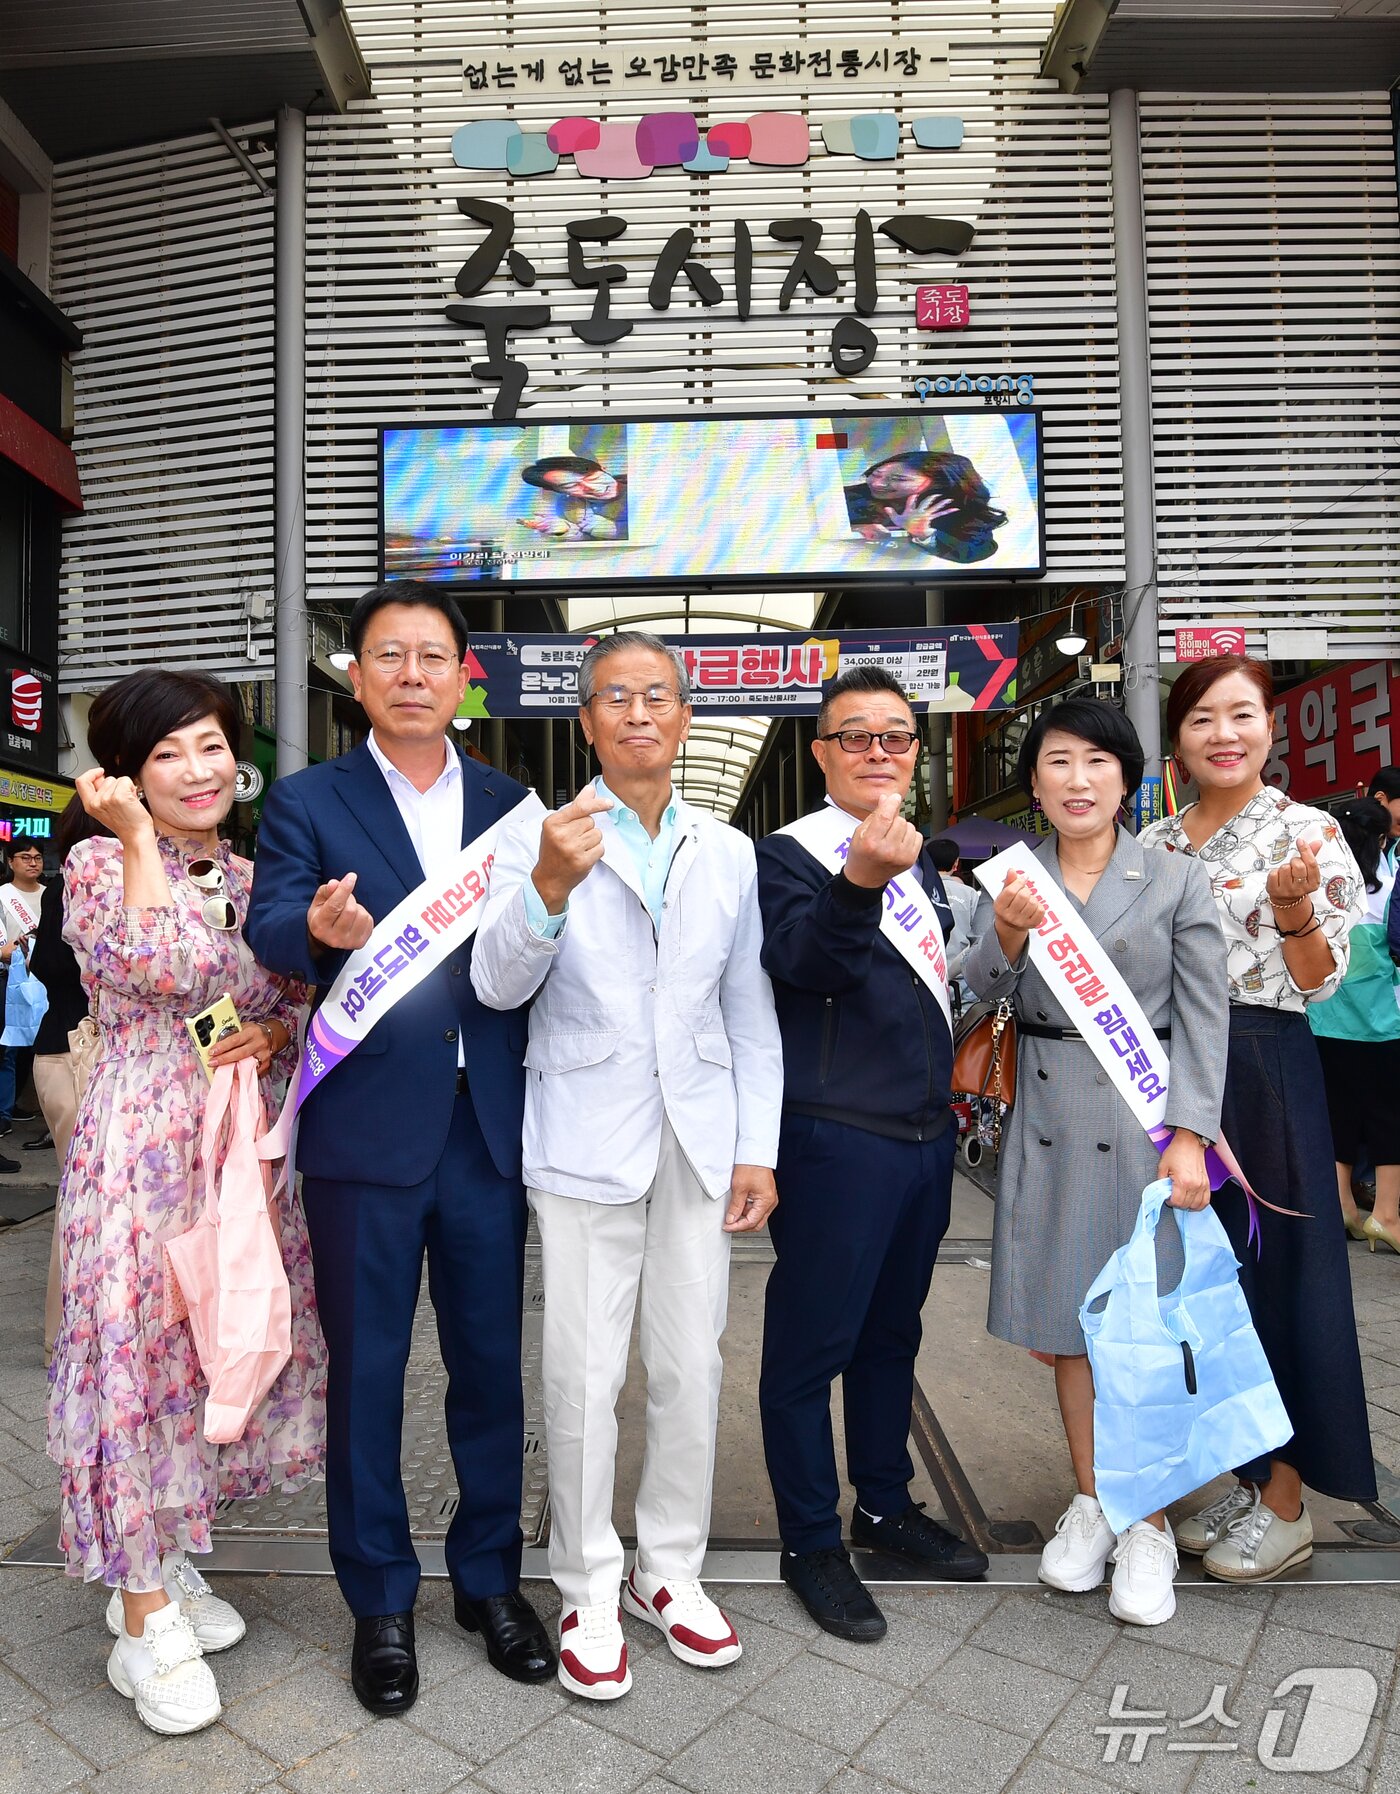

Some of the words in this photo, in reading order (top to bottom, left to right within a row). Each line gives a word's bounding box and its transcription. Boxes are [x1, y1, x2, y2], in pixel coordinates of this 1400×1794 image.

[464, 58, 544, 90] 없는게
[558, 57, 613, 86] 없는
[624, 53, 738, 82] 오감만족
[750, 47, 921, 79] 문화전통시장
[921, 289, 964, 306] 죽도
[445, 197, 879, 420] 죽도시장
[921, 305, 965, 324] 시장
[984, 395, 1011, 406] 포항시
[1179, 631, 1194, 641] 공공
[1179, 639, 1210, 649] 와이파이
[844, 657, 884, 666] 34,000원
[886, 656, 903, 664] 이상
[918, 655, 939, 663] 1만원
[1179, 648, 1218, 658] 서비스지역
[916, 668, 939, 677] 2만원
[928, 681, 941, 690] 가능
[548, 696, 565, 704] 10월
[717, 695, 740, 703] 17:00
[11, 780, 53, 806] 시장큰약국
[1140, 783, 1150, 808] 이곳에
[13, 817, 51, 838] 커피
[420, 870, 486, 935] 여러분
[340, 923, 430, 1023] 힘내세요
[1047, 932, 1109, 1008] 여러분
[1093, 1003, 1168, 1104] 힘내세요
